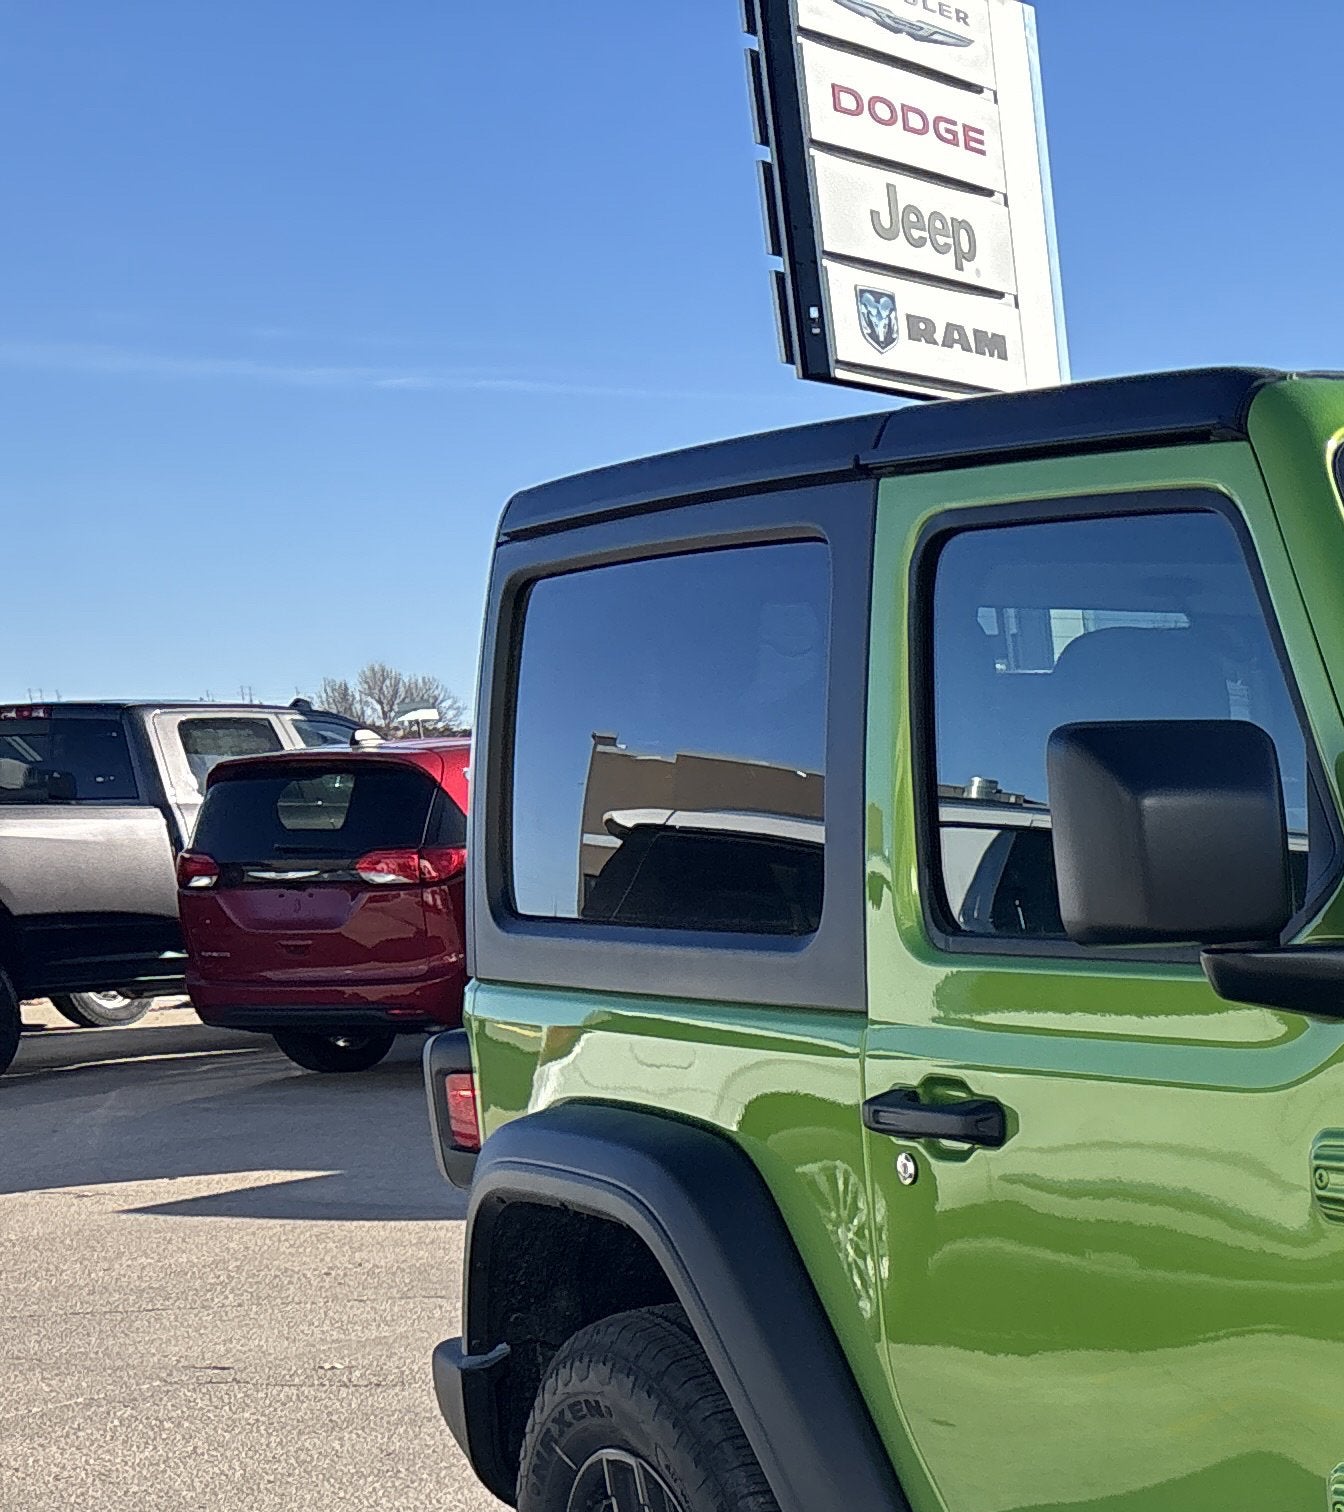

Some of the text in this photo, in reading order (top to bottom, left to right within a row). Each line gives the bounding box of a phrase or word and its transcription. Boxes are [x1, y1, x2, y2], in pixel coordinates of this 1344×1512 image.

[831, 83, 987, 156] DODGE
[870, 183, 977, 271] Jeep
[906, 313, 1009, 361] RAM
